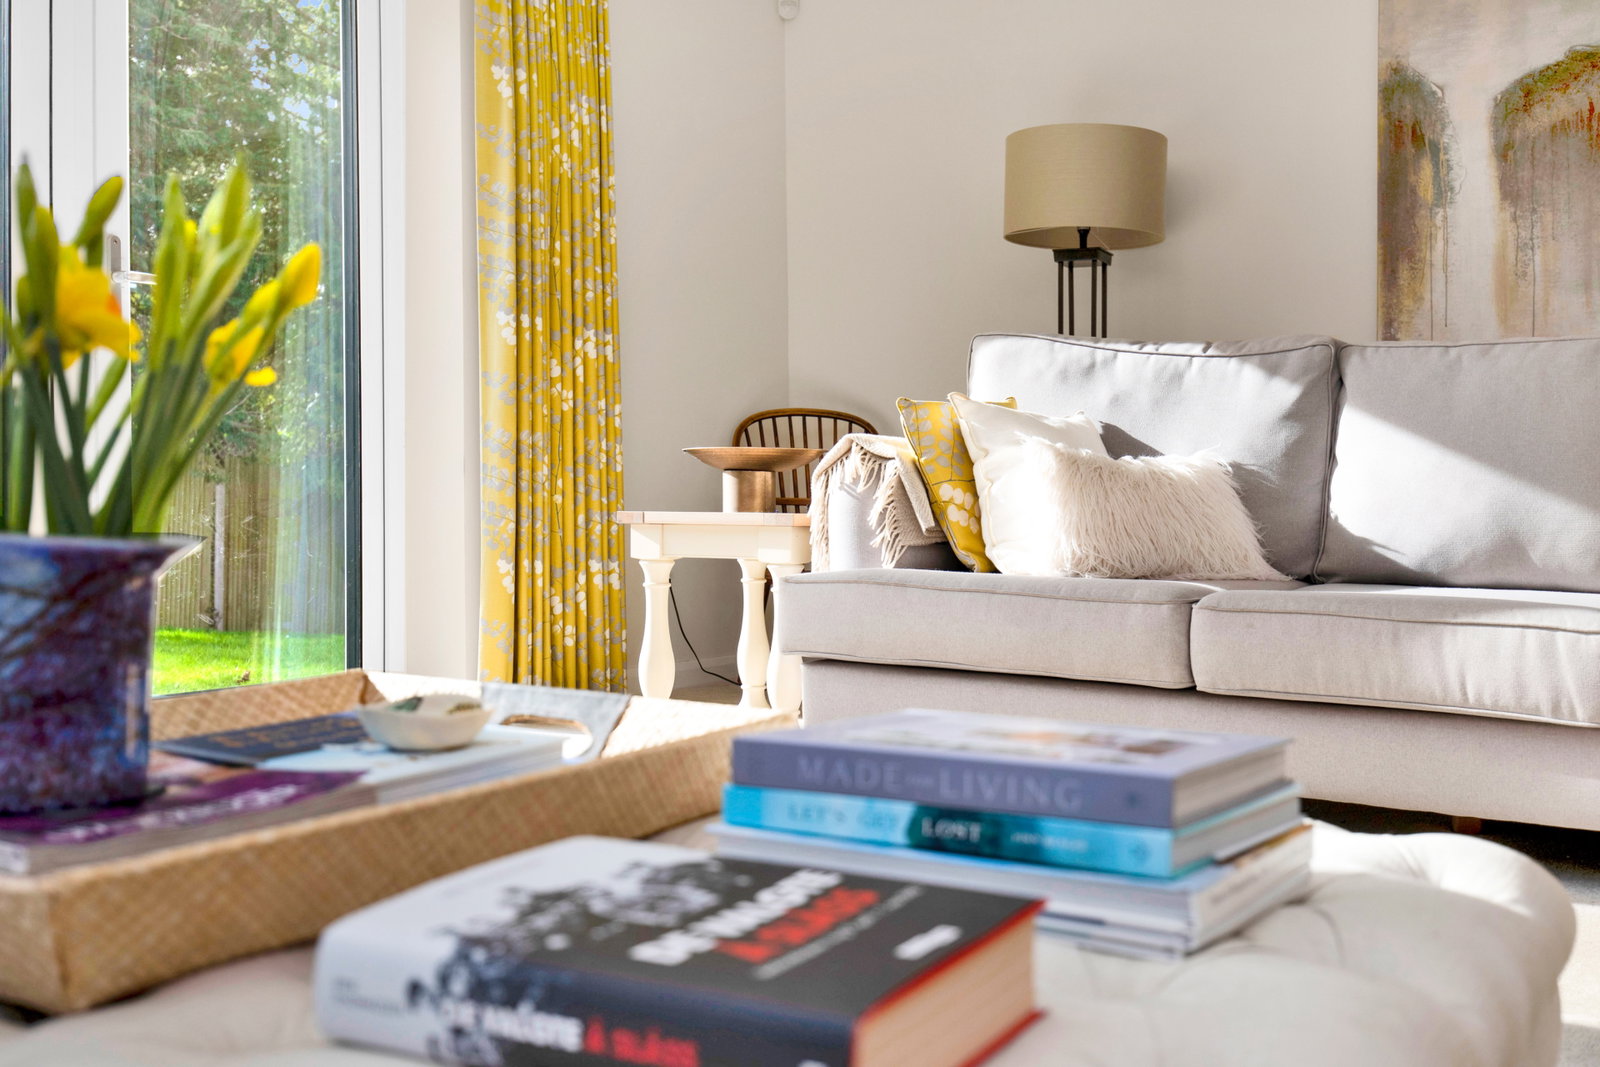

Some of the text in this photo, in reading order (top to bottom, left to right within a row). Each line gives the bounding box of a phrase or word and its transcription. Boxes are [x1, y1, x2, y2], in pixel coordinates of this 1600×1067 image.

[797, 754, 1084, 812] MADE LIVING
[920, 815, 983, 844] LOST
